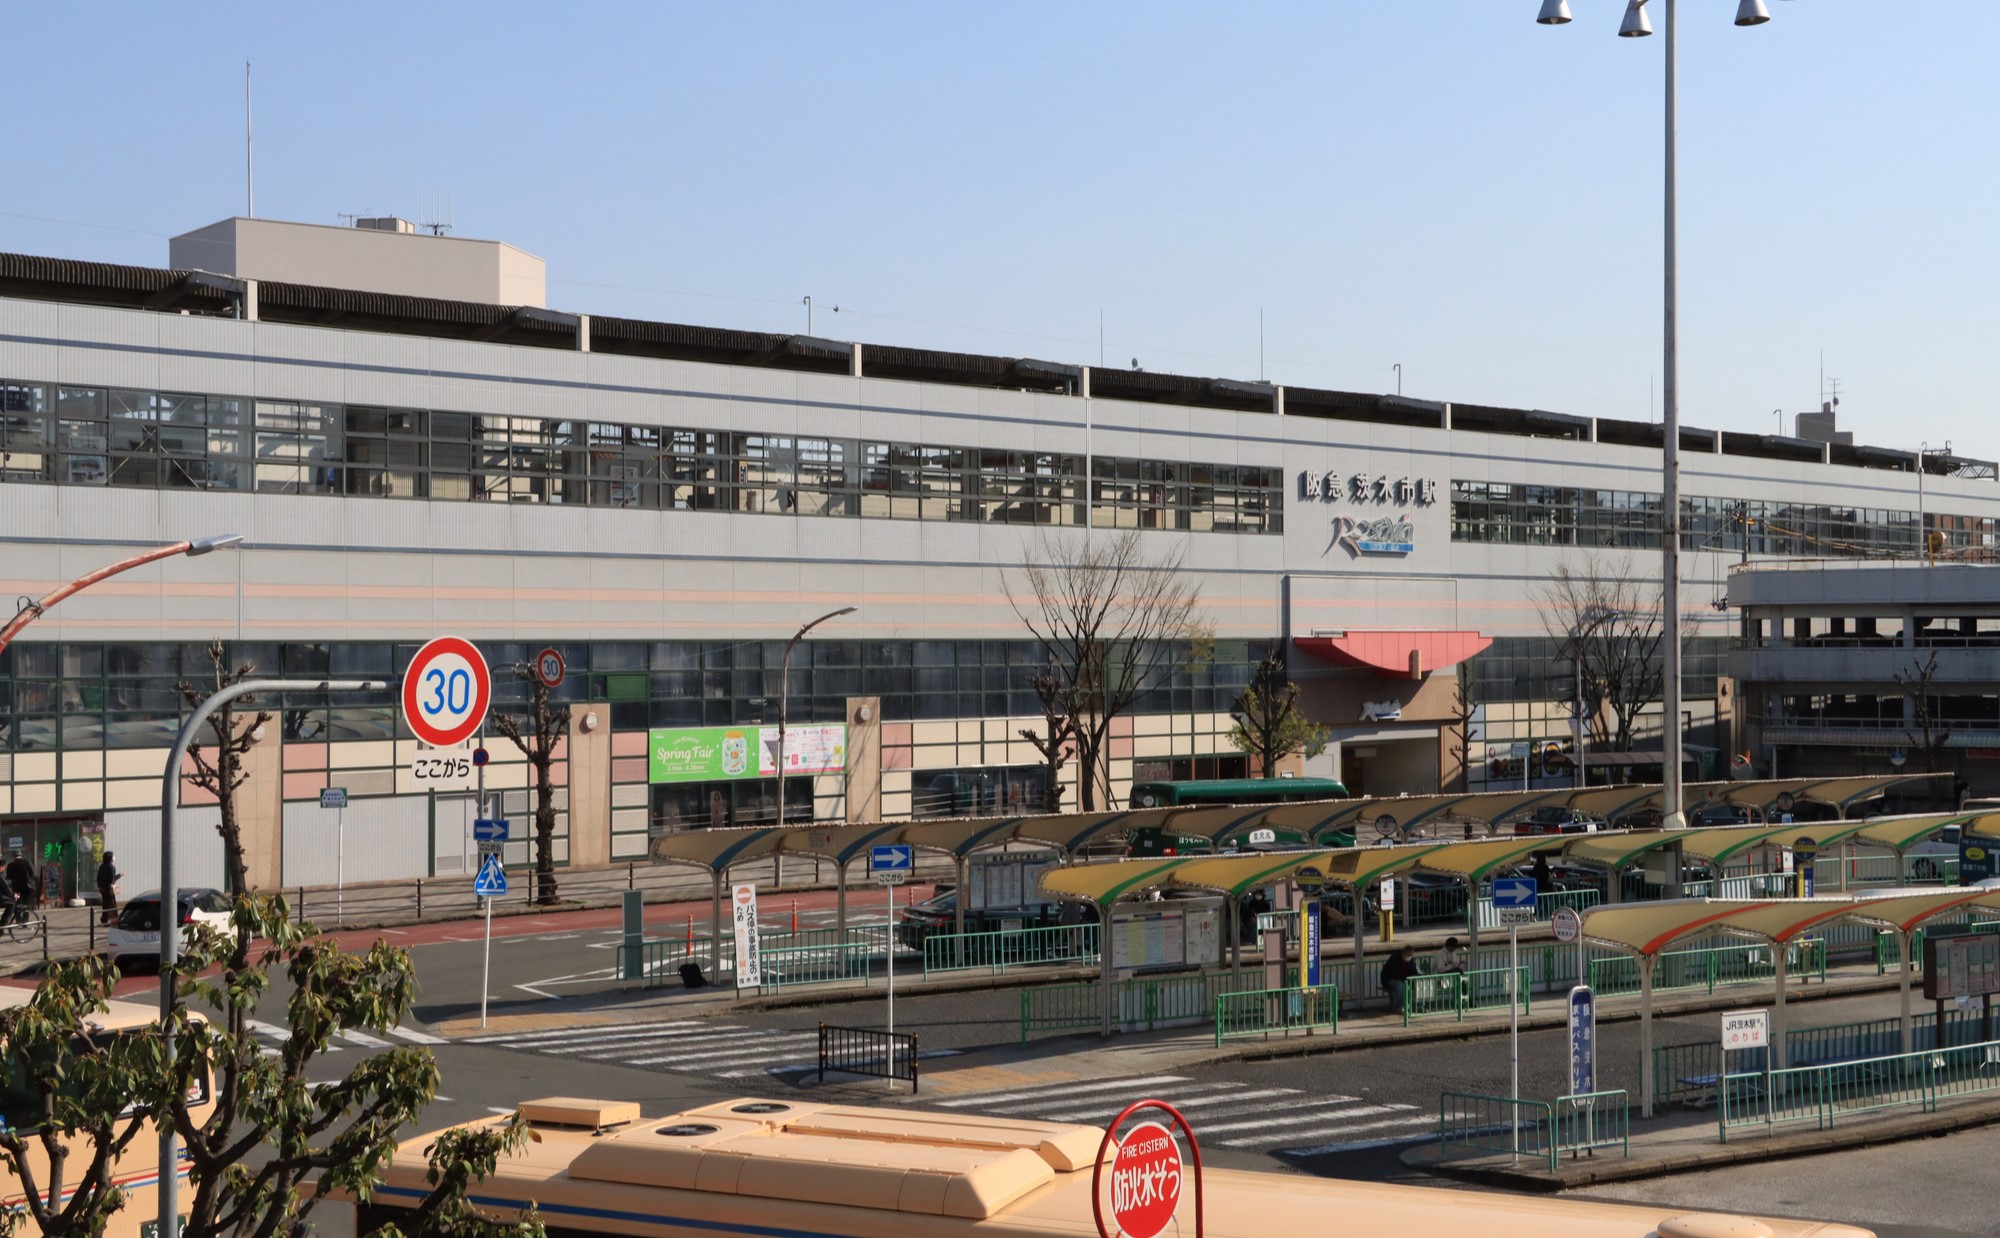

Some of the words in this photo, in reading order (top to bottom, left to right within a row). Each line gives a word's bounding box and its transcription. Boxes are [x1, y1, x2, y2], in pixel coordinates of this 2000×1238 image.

[1304, 469, 1437, 503] 阪急茨木市駅
[543, 659, 560, 676] 30
[423, 668, 470, 715] 30
[656, 747, 692, 765] Spring
[692, 745, 715, 759] Fair
[414, 758, 471, 779] ここから
[879, 873, 904, 883] ここから
[736, 906, 744, 922] ため
[1501, 912, 1530, 923] ここから
[1731, 1030, 1760, 1042] のりば
[1572, 1004, 1581, 1089] 京阪バスのりば
[1121, 1143, 1138, 1160] FIRE
[1138, 1135, 1169, 1156] CISTERN
[1113, 1156, 1180, 1215] 防火水そう
